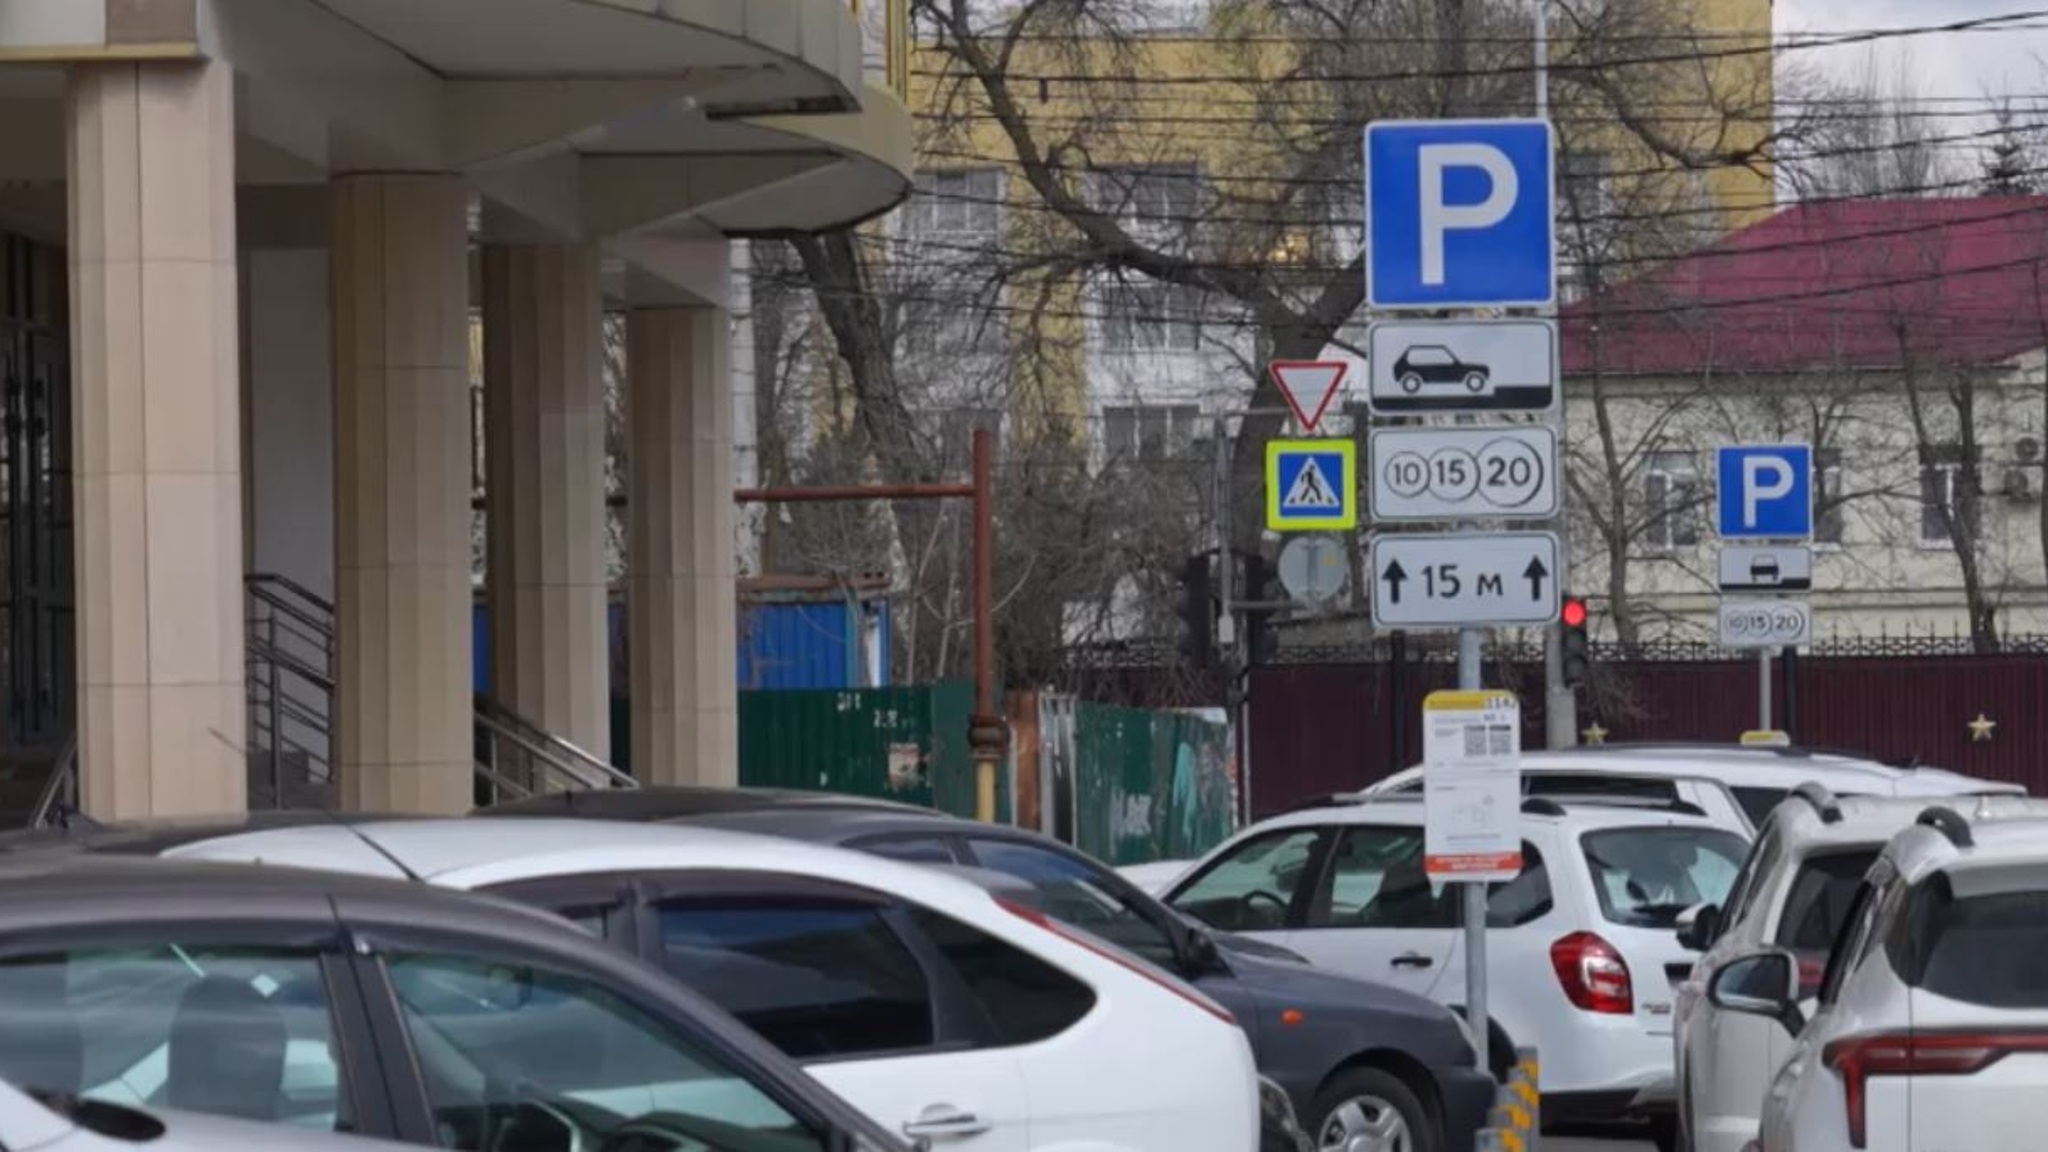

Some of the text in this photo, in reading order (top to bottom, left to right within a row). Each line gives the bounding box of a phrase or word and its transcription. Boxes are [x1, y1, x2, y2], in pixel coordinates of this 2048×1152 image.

[1418, 143, 1519, 285] P
[1393, 456, 1531, 487] 10 15 20
[1743, 456, 1795, 528] P
[1421, 563, 1461, 599] 15
[1751, 615, 1766, 630] 15
[1775, 614, 1799, 629] 20
